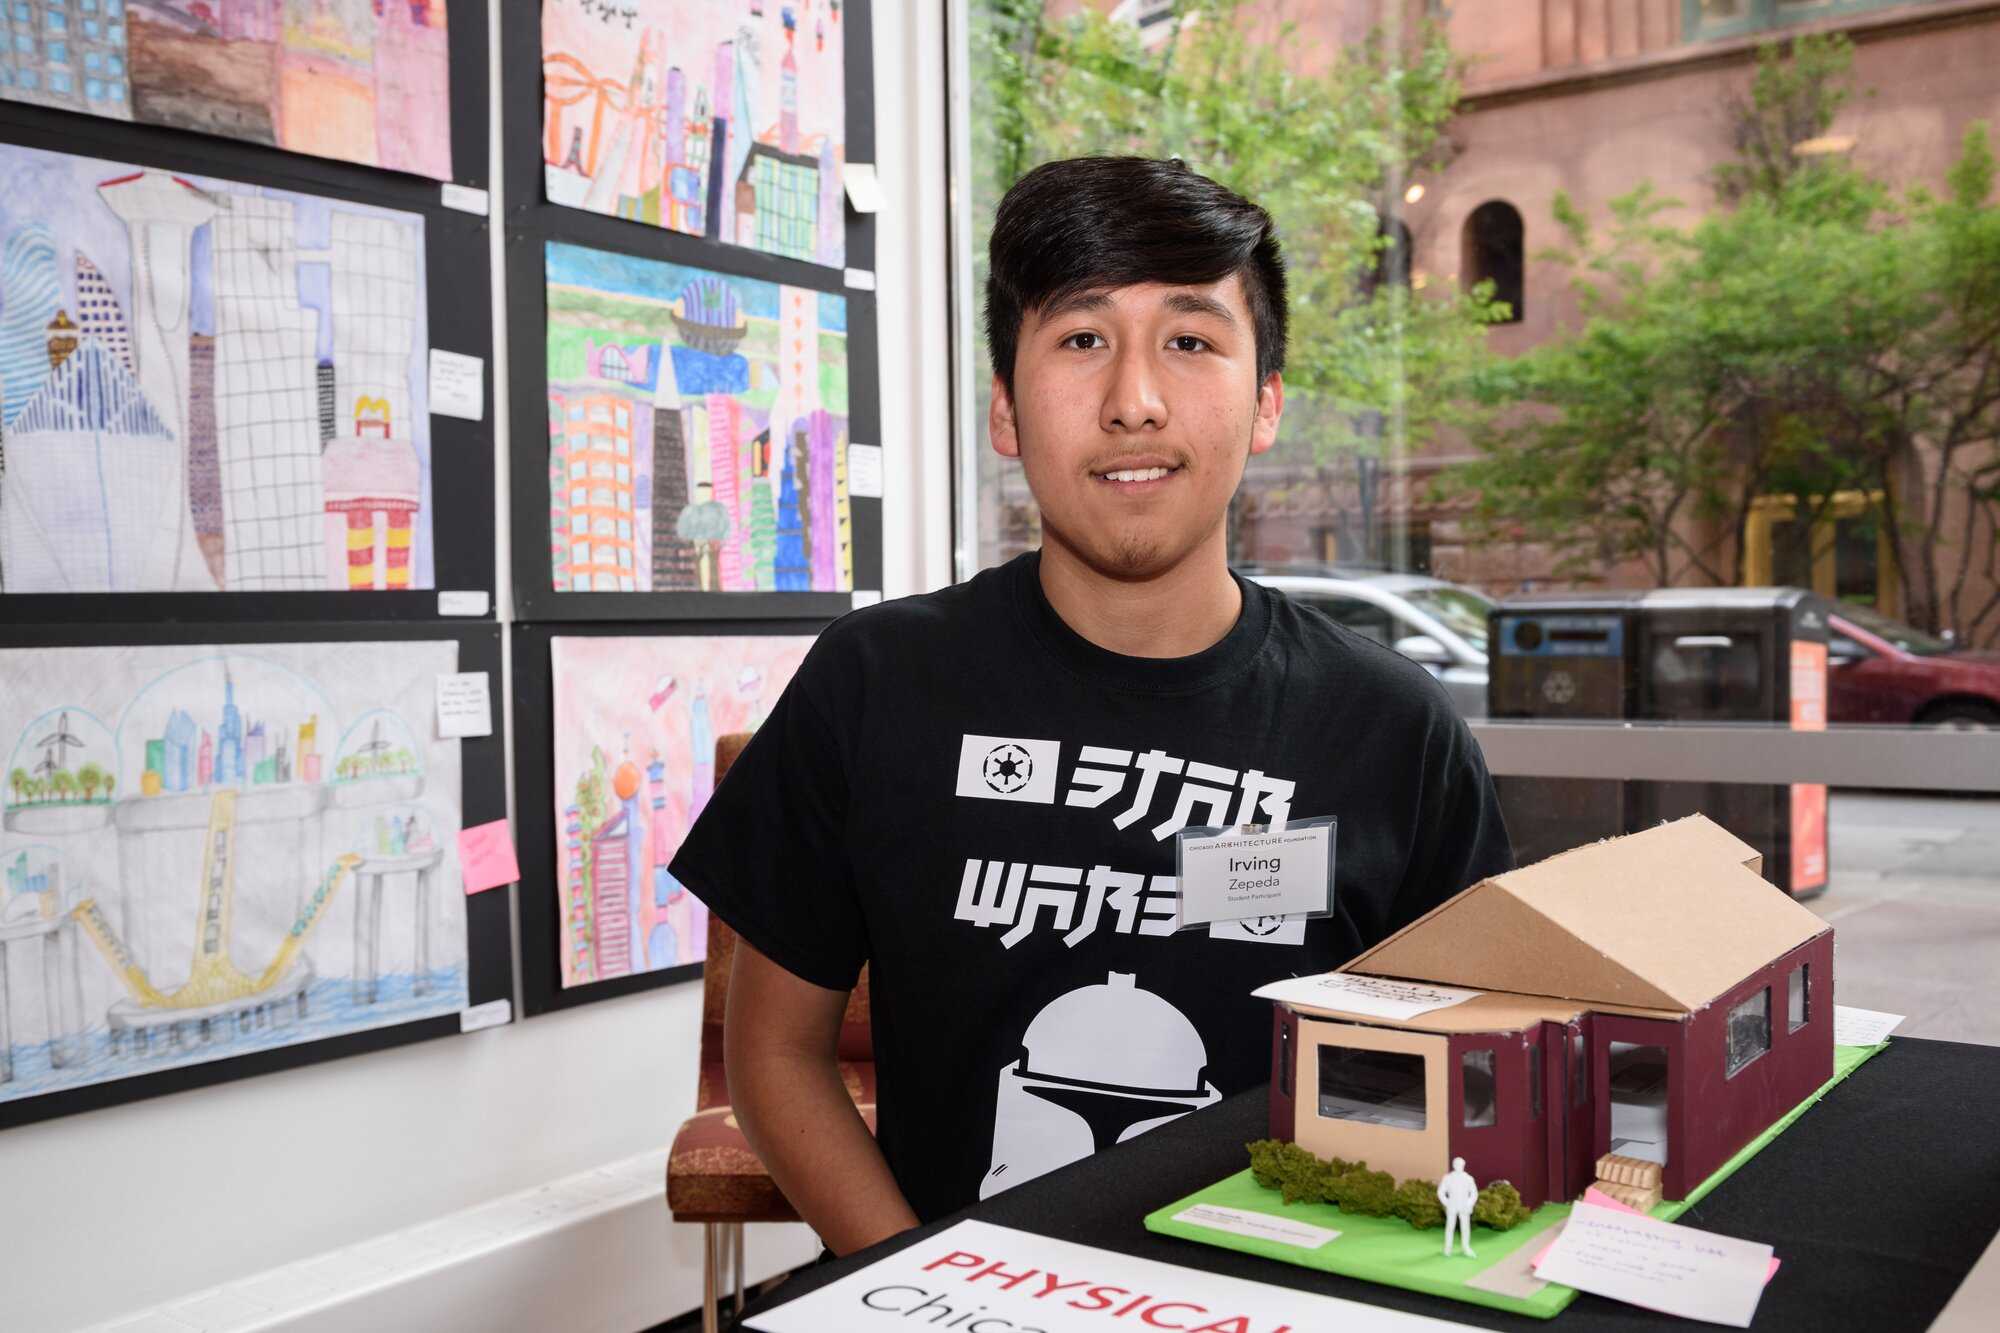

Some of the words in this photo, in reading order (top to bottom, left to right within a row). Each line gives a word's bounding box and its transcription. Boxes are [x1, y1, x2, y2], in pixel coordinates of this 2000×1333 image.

[1065, 745, 1297, 842] STAR
[1229, 856, 1281, 873] Irving
[1229, 876, 1280, 891] Zepeda
[1228, 893, 1250, 902] Student
[921, 1250, 1292, 1333] PHYSICA
